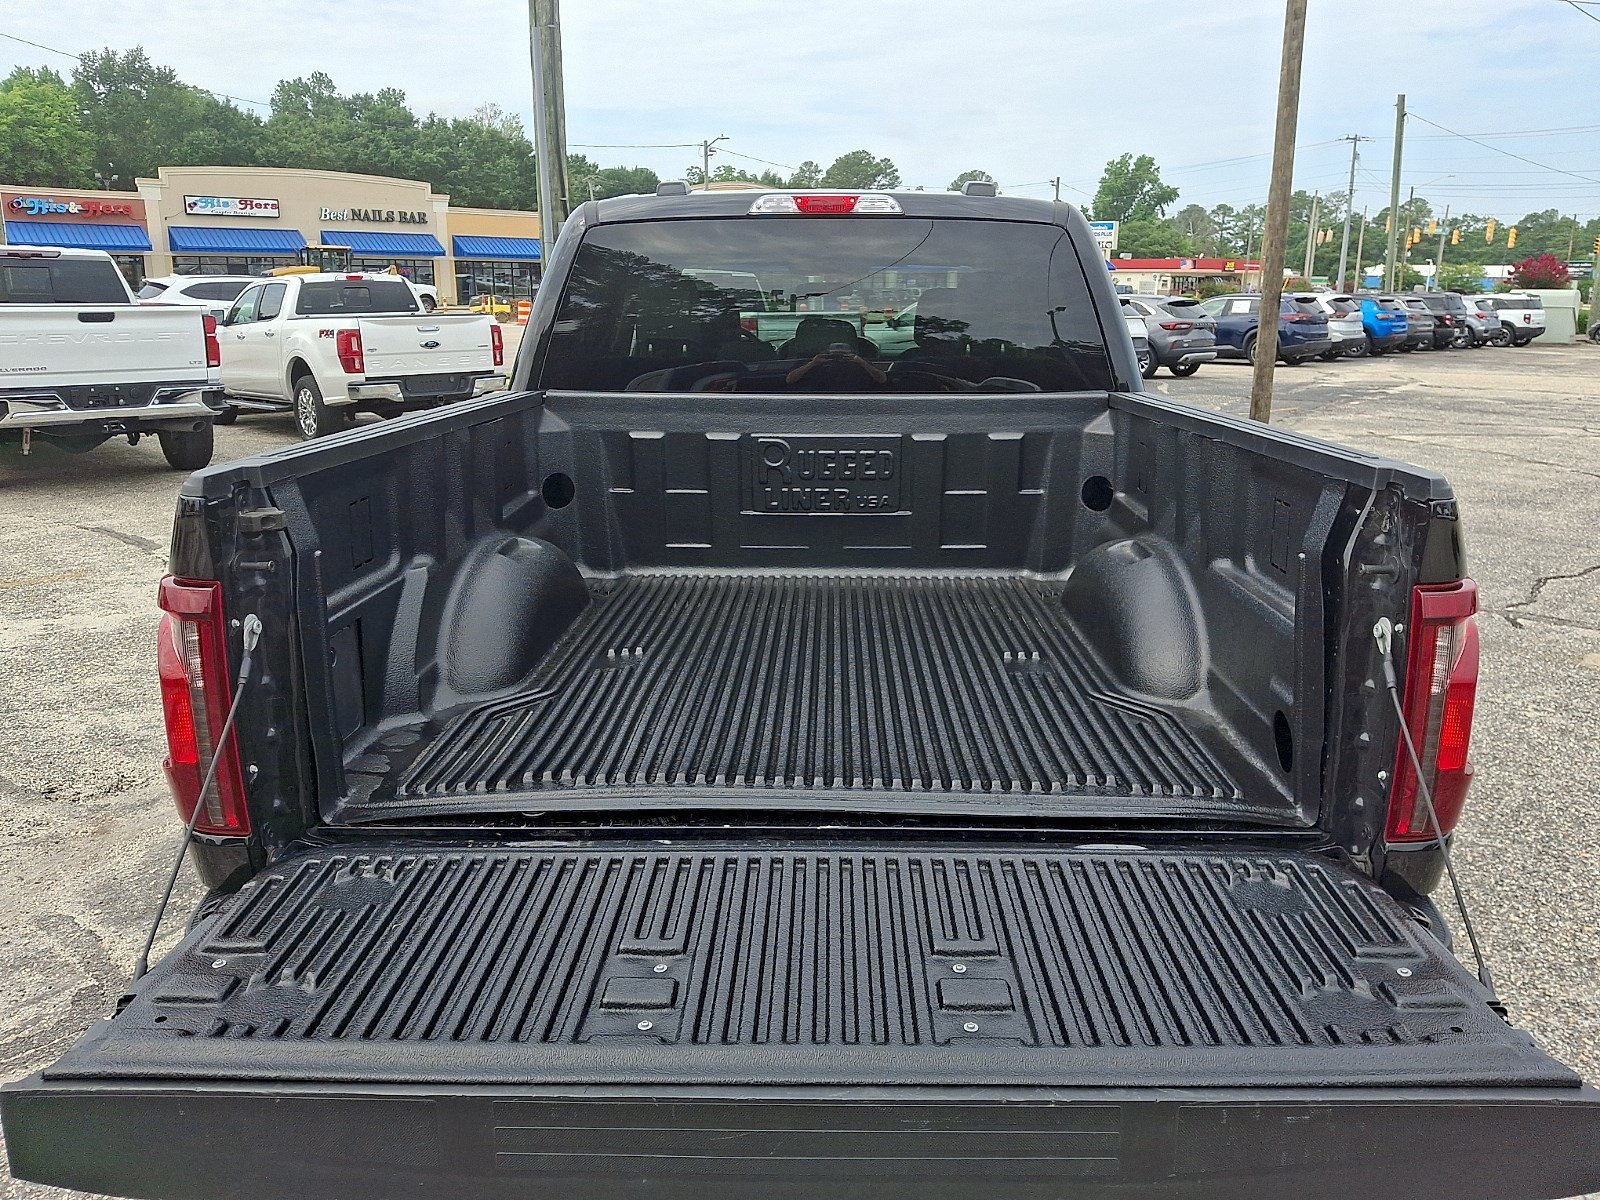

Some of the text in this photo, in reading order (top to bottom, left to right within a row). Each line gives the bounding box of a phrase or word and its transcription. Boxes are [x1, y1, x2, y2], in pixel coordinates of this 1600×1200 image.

[26, 198, 132, 219] His & Hers
[197, 197, 230, 209] His
[238, 200, 279, 210] Hers
[320, 207, 428, 224] Best NAILS BAR
[319, 329, 335, 339] FX4
[757, 438, 894, 484] RUGGED
[765, 487, 890, 511] LINER USA
